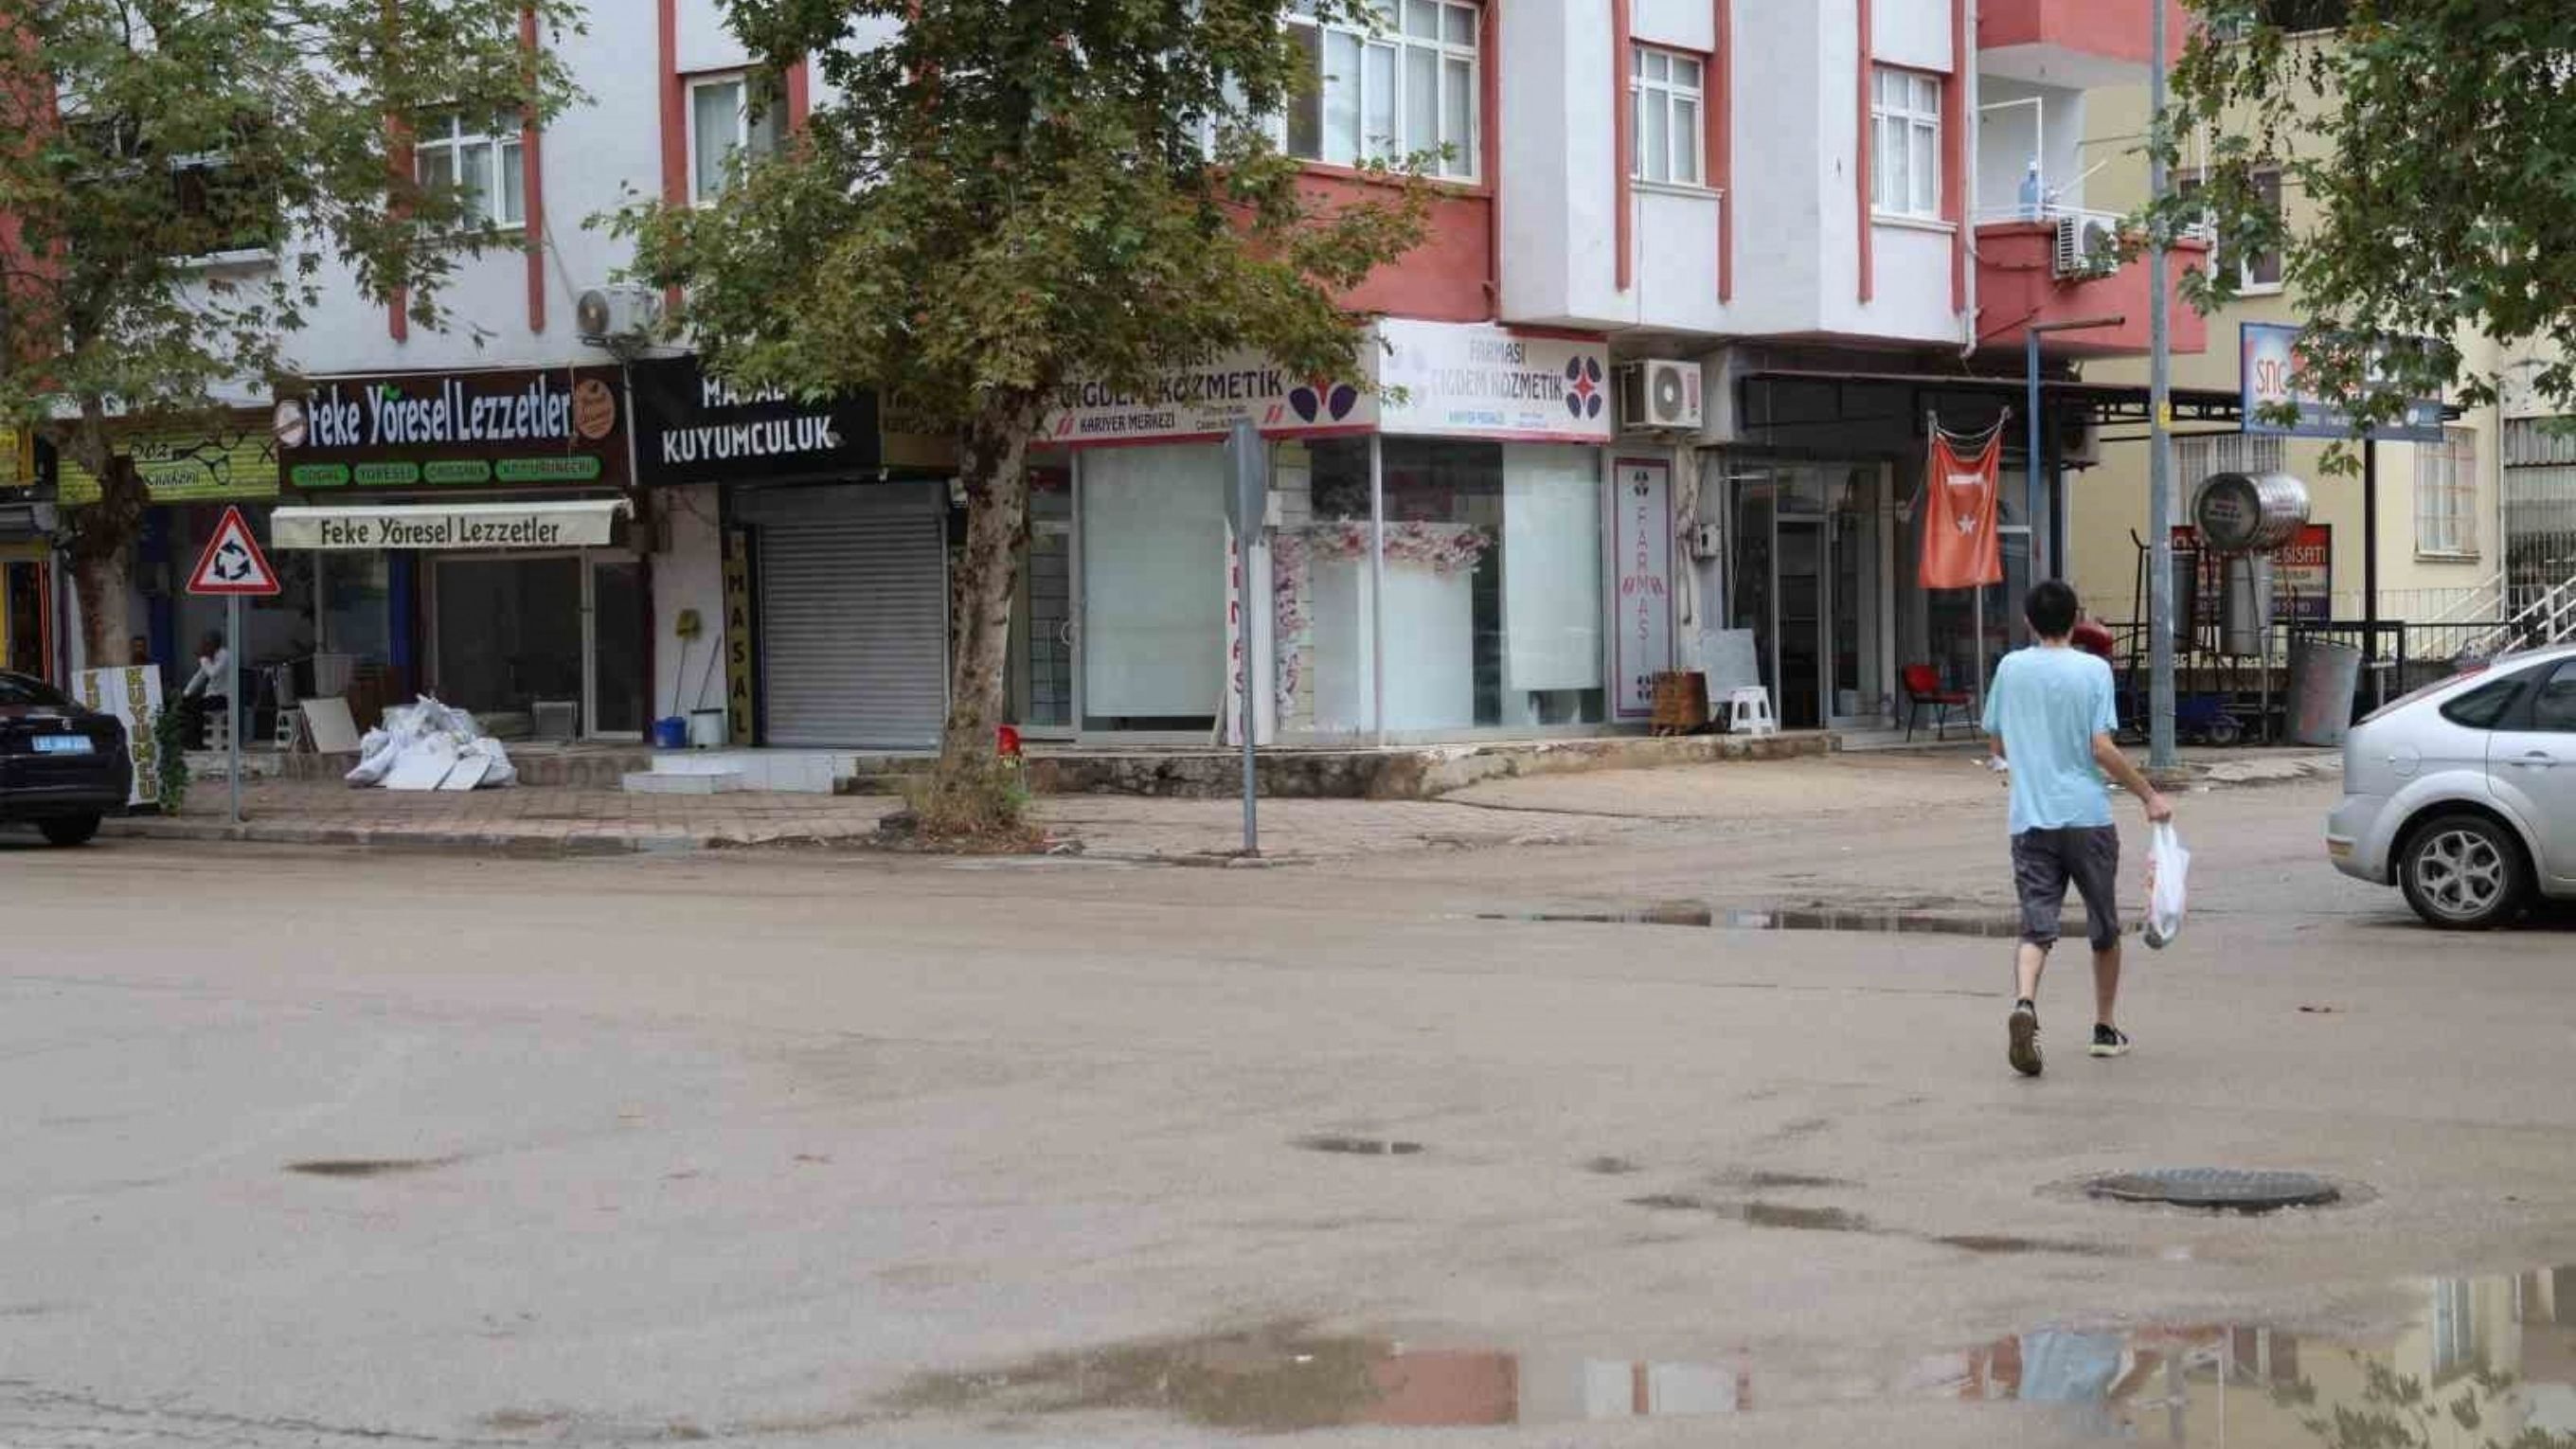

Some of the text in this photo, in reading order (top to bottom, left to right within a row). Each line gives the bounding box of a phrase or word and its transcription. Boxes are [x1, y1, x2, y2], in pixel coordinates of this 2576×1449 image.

[455, 374, 571, 441] Lezzetler
[702, 378, 787, 408] MAAL
[662, 415, 835, 464] KUYUMCULUK
[321, 516, 559, 546] Feke Yöresel Lezzetler
[727, 574, 747, 733] MASAL
